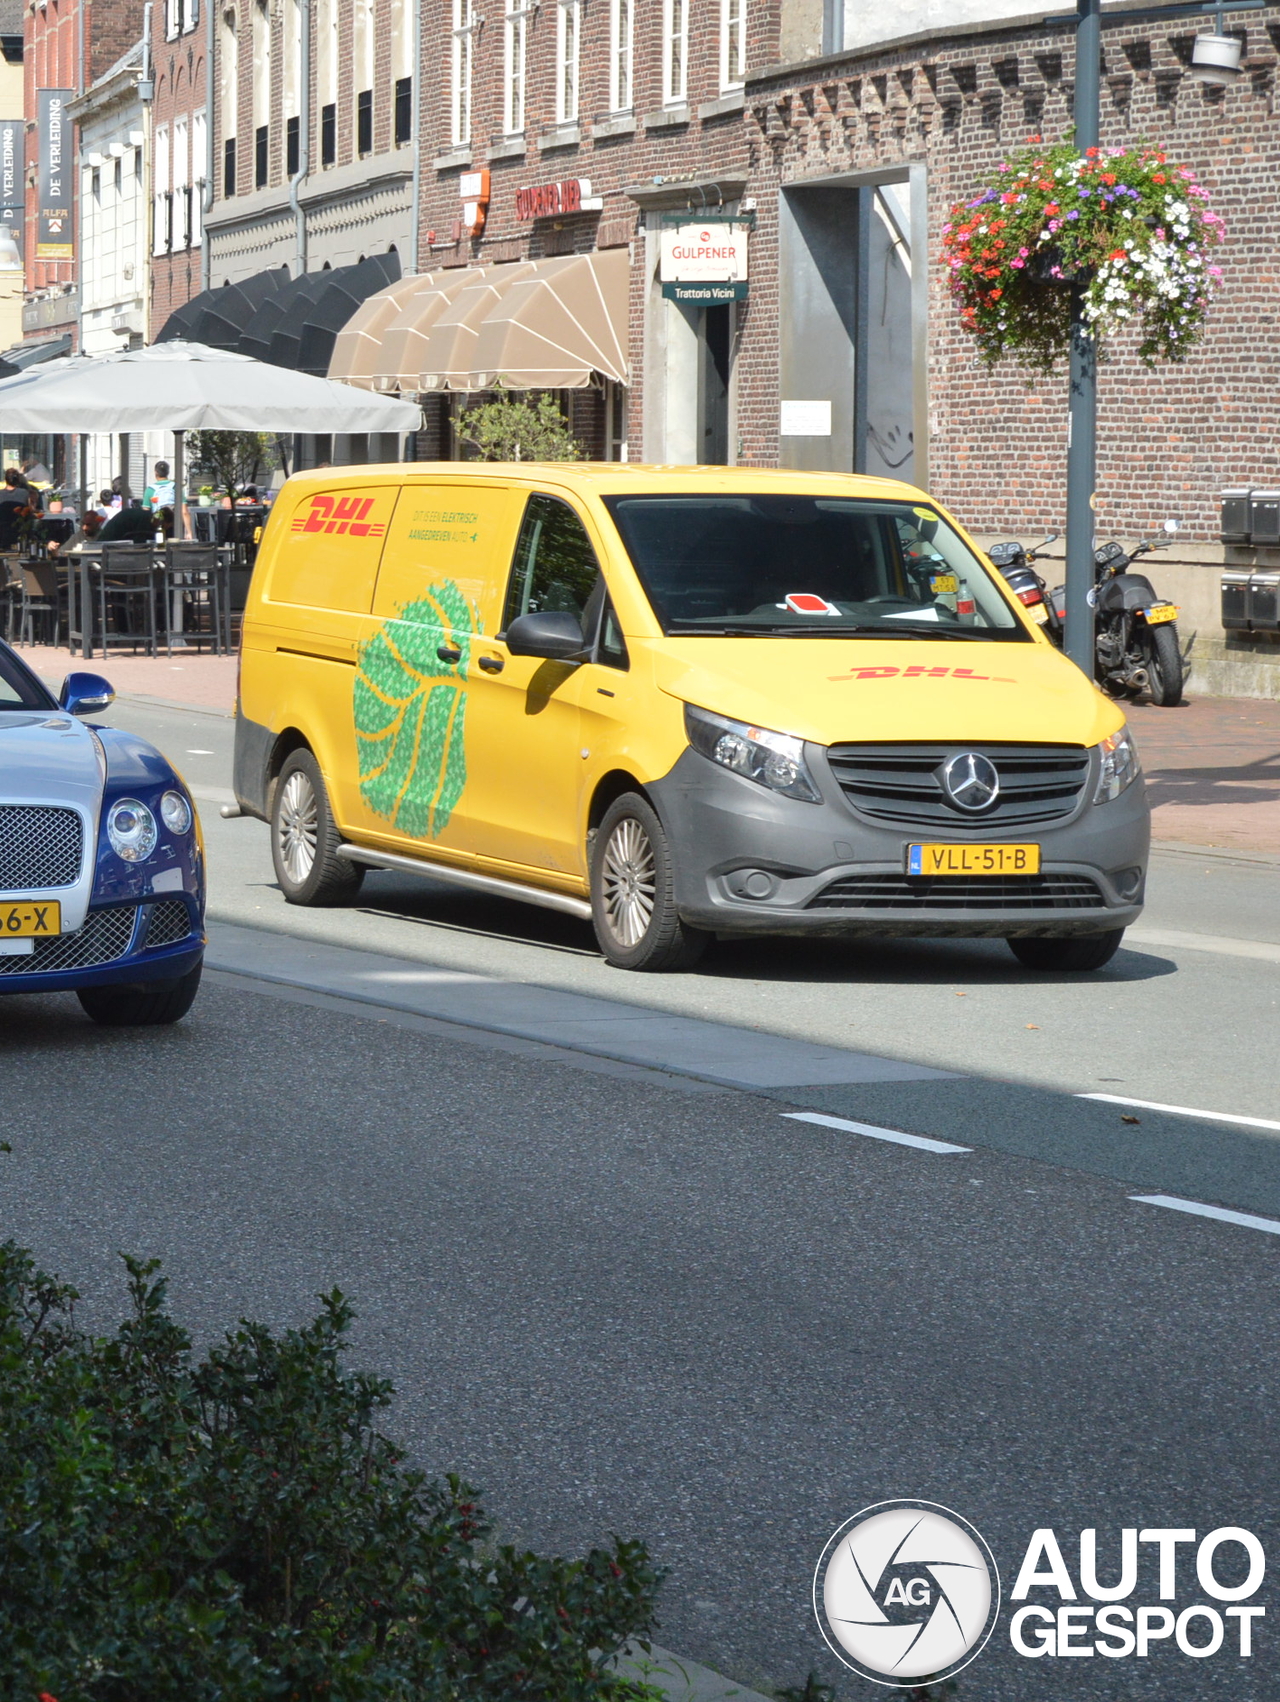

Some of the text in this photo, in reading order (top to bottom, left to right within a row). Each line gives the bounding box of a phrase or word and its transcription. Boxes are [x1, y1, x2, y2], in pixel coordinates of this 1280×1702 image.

[50, 98, 61, 196] DE VERLEIDING
[3, 128, 14, 198] VERLEIDING
[42, 208, 68, 217] ALFA
[672, 246, 736, 259] GULPENER
[674, 288, 734, 298] Trattoria Vicini
[302, 495, 376, 537] DHL
[441, 512, 478, 523] ELEKTRISCH
[408, 529, 451, 542] AANGEDREVEN
[850, 666, 990, 680] DHL
[932, 848, 1026, 870] VLL-51-B
